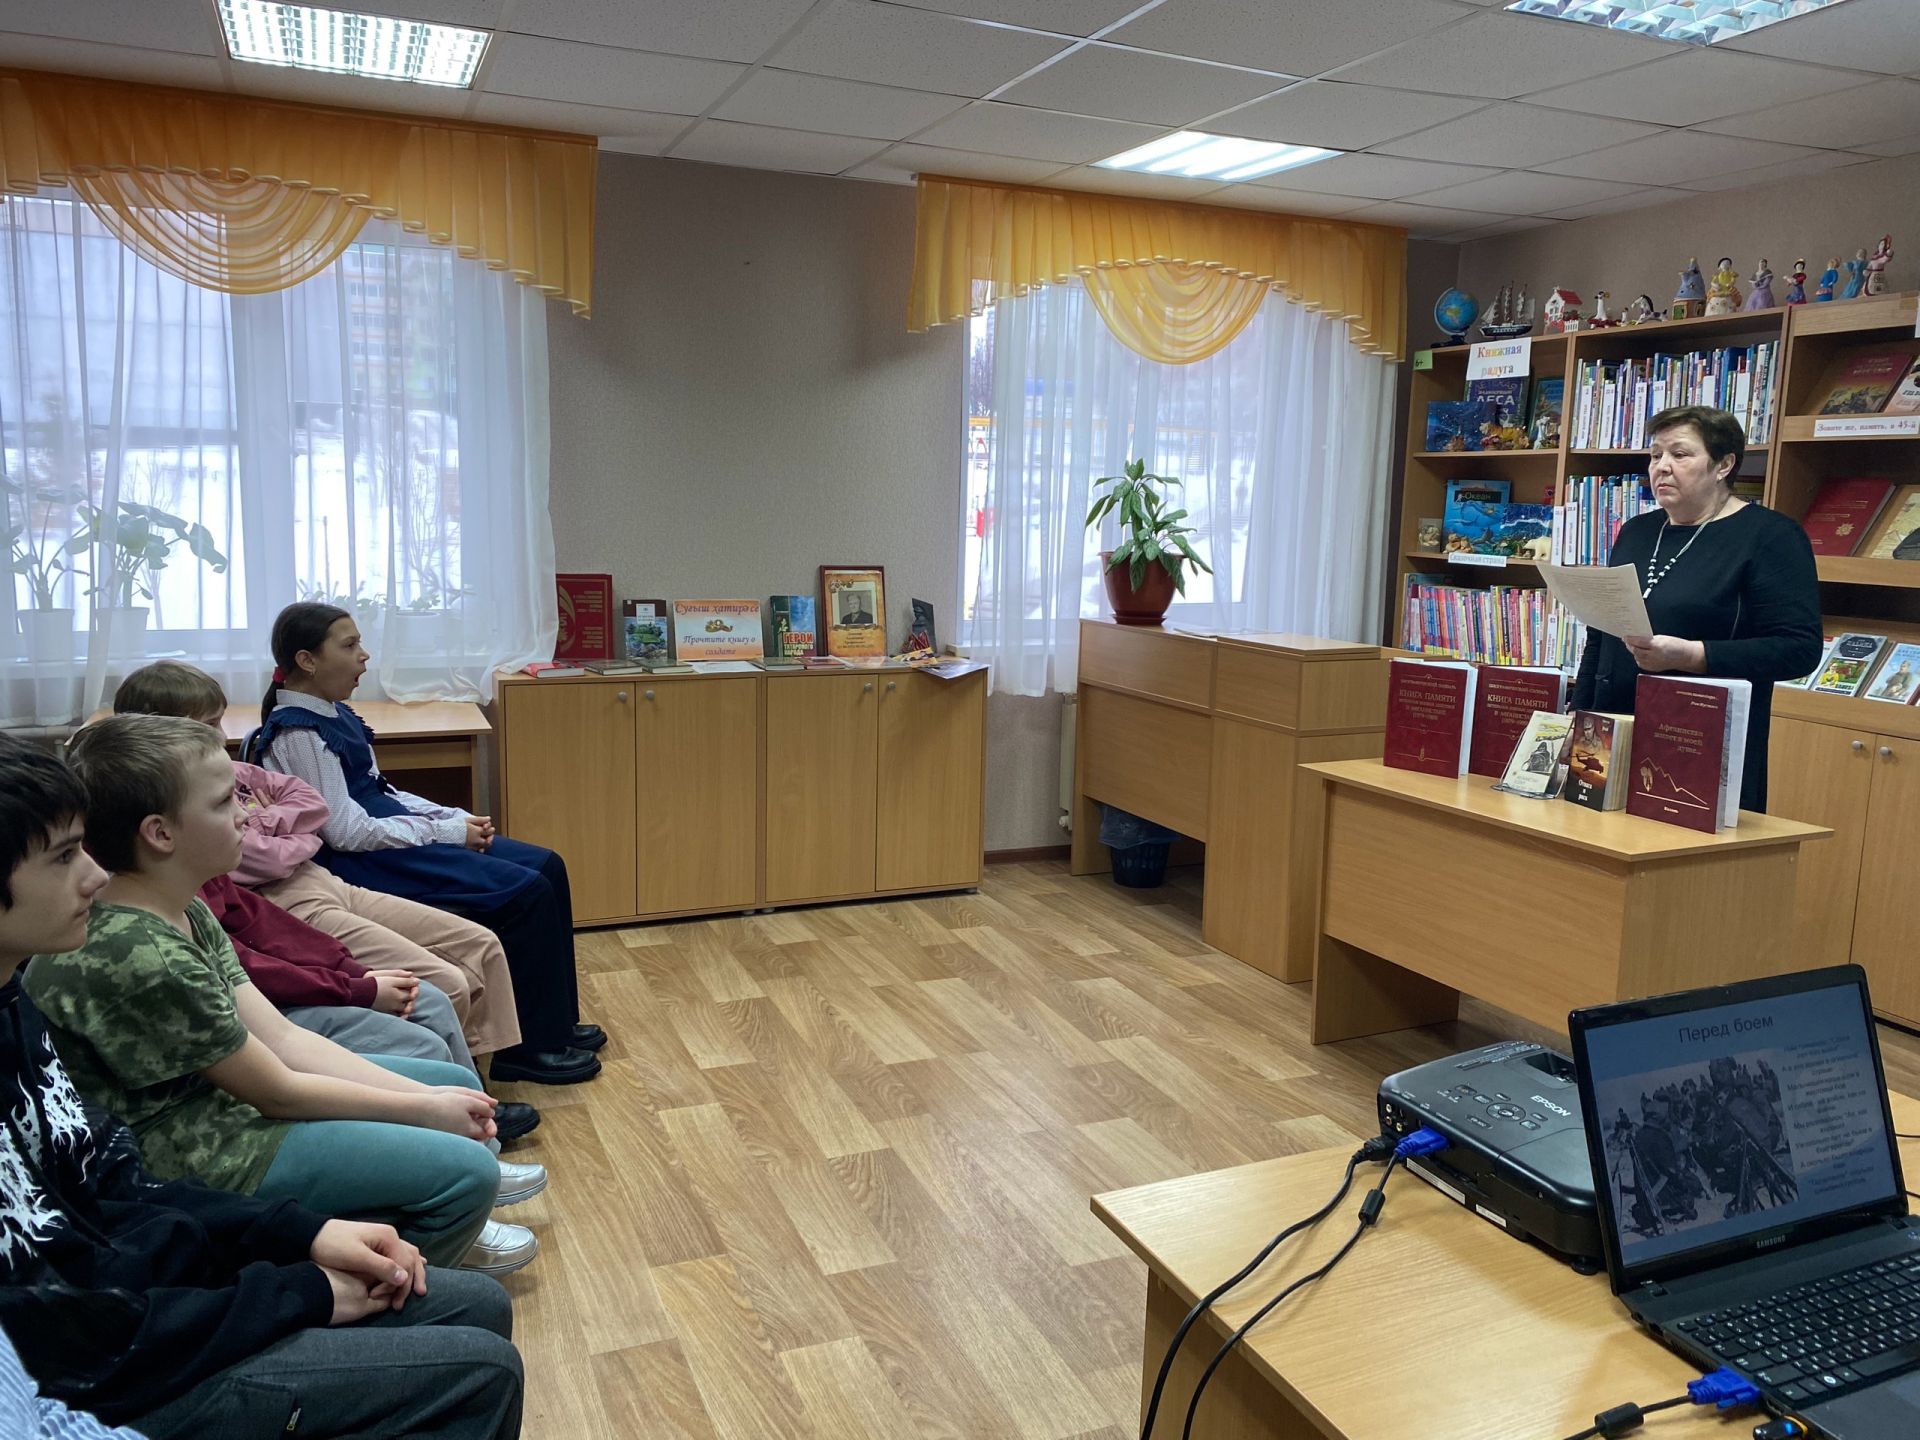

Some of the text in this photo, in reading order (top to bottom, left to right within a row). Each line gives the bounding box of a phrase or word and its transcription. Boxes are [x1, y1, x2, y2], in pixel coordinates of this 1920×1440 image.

[1478, 345, 1522, 358] Книжная
[1481, 365, 1514, 378] радуга
[1898, 420, 1916, 430] 45-й
[1465, 492, 1491, 500] Океан
[676, 604, 709, 615] Сугыш
[683, 635, 726, 645] Прочтите
[728, 637, 749, 645] книгу
[783, 632, 814, 643] ГЕРОИ
[705, 646, 736, 655] солдате
[1400, 690, 1456, 703] КНИГА ПАМЯТИ
[1488, 694, 1512, 704] КНИГА
[1514, 697, 1548, 708] ПАМЯТИ
[1679, 1015, 1774, 1043] Перед боем
[1530, 1095, 1571, 1116] EPSON
